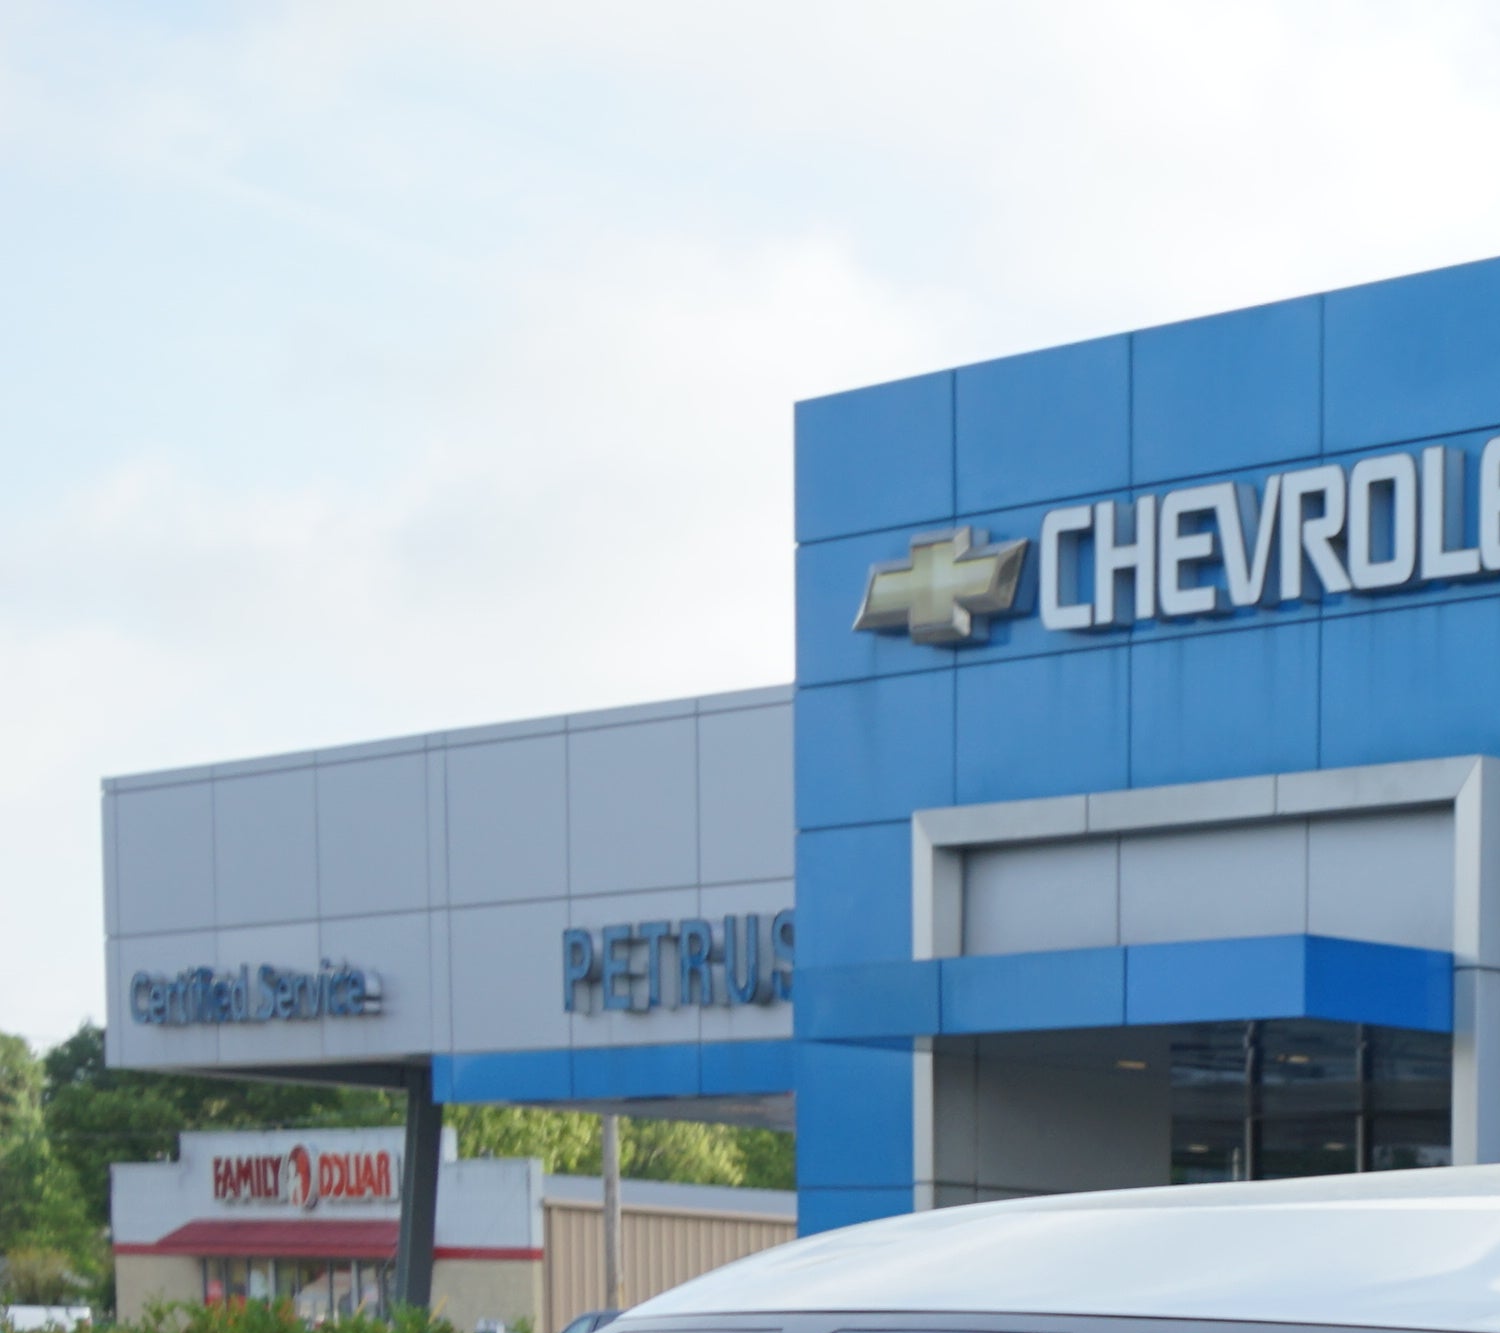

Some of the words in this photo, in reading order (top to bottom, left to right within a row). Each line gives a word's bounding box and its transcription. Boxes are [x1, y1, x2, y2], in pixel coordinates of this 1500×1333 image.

[130, 962, 249, 1025] Certified
[257, 958, 368, 1020] Service
[562, 909, 795, 1013] PETRUS
[213, 1155, 282, 1199] FAMILY
